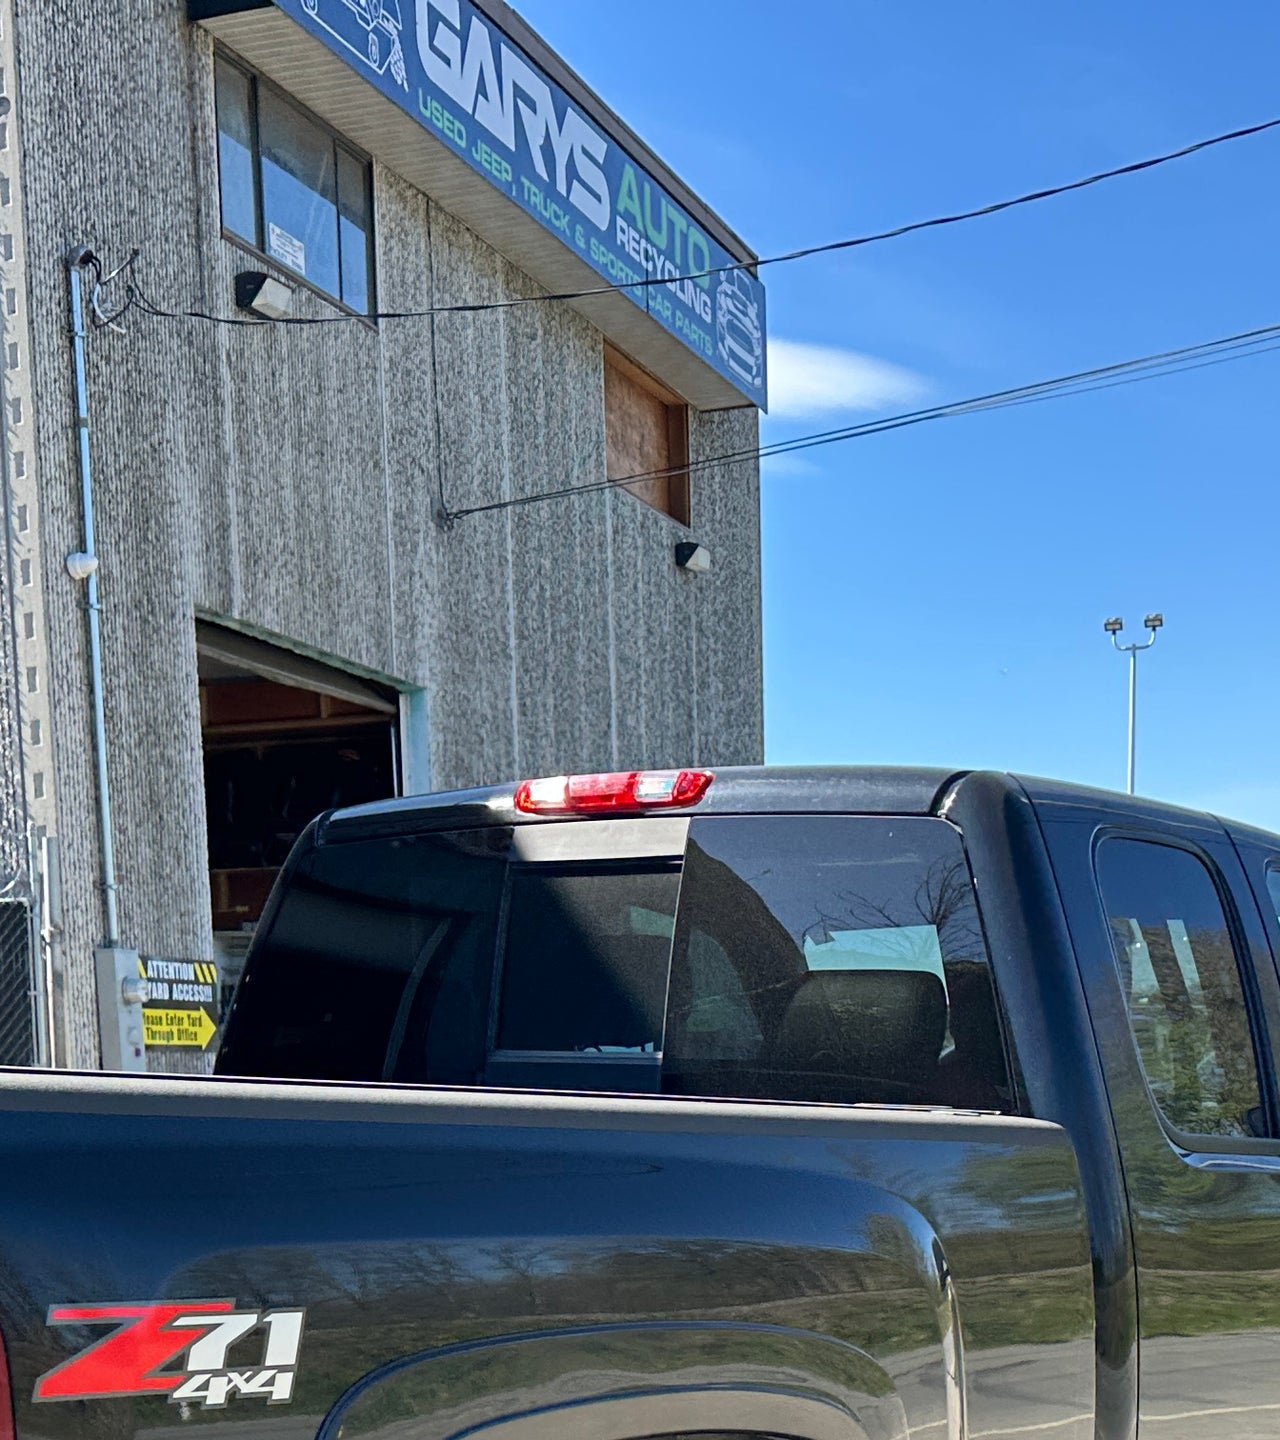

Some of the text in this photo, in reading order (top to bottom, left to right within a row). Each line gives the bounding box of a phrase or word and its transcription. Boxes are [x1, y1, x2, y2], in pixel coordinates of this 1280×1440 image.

[415, 0, 609, 231] GARYS
[418, 87, 467, 149] USED
[521, 175, 570, 237] TRUCK
[574, 223, 586, 250] &
[590, 236, 642, 298] SPORTS
[646, 283, 673, 323] CAR
[675, 311, 713, 357] PARTS
[616, 162, 710, 290] AUTO
[616, 215, 712, 323] RECYCLING
[147, 960, 195, 981] ATTENTION
[165, 1012, 184, 1026] Enter
[187, 1013, 203, 1028] Yard
[145, 1027, 175, 1043] Through
[34, 1300, 305, 1400] Z71
